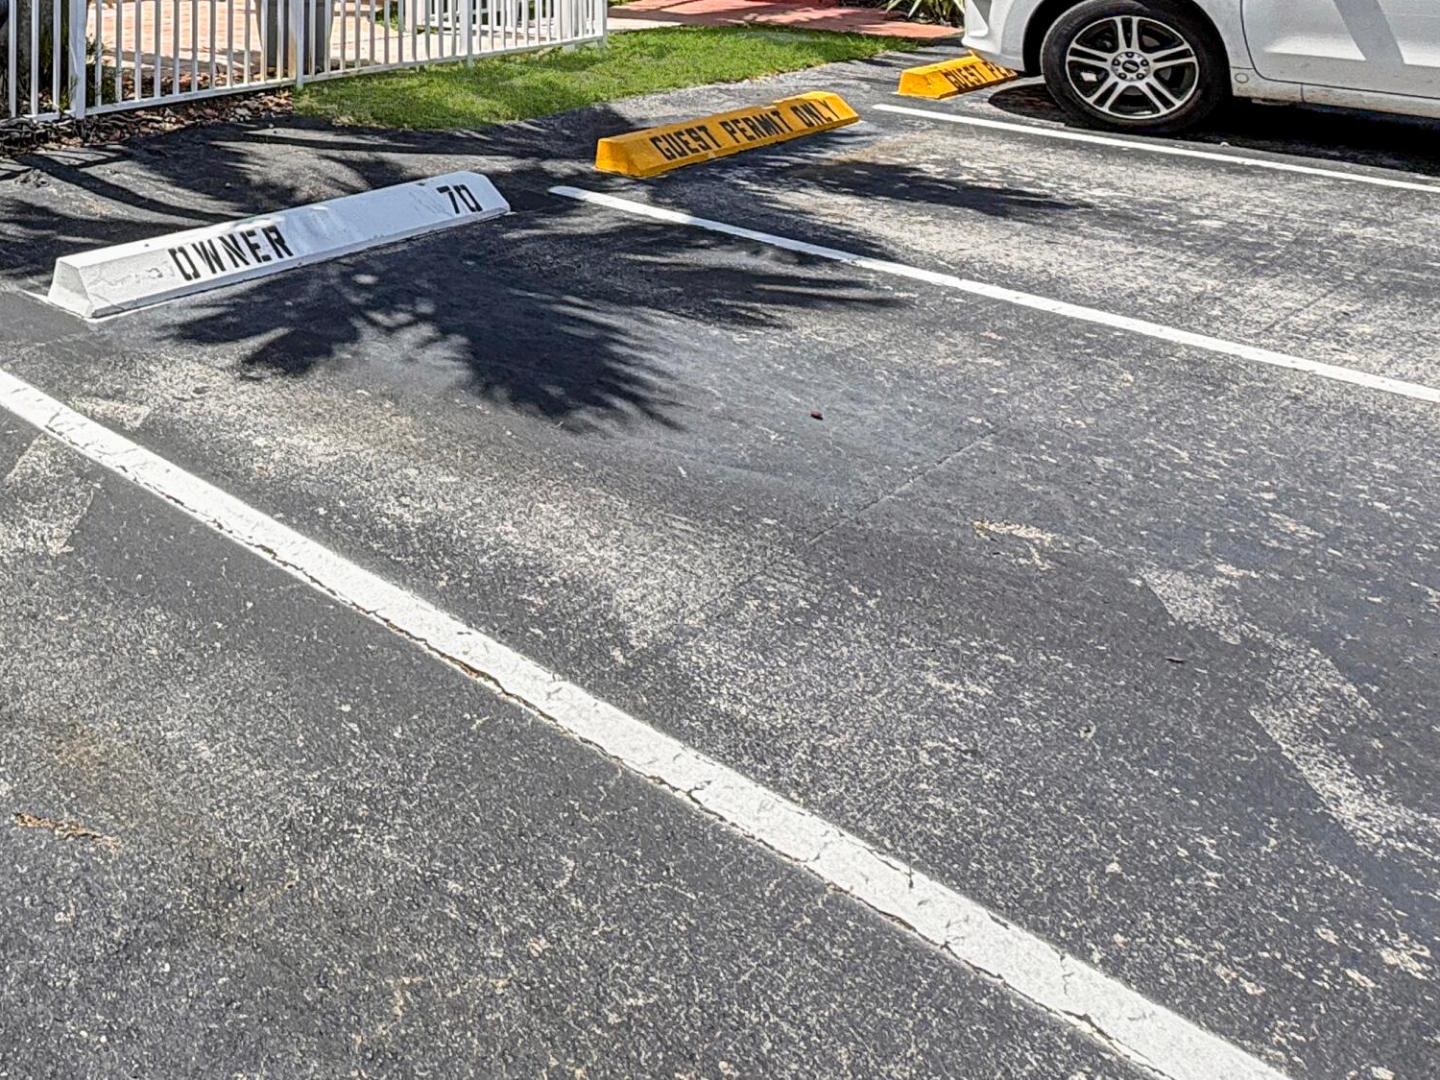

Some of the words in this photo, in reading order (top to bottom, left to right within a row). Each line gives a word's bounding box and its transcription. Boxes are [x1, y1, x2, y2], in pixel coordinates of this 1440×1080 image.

[941, 64, 988, 89] GUEST
[649, 125, 721, 161] GUEST
[720, 110, 793, 143] PERMIT
[790, 100, 840, 127] ONLY
[168, 224, 295, 281] OWNER
[436, 183, 484, 214] 70
